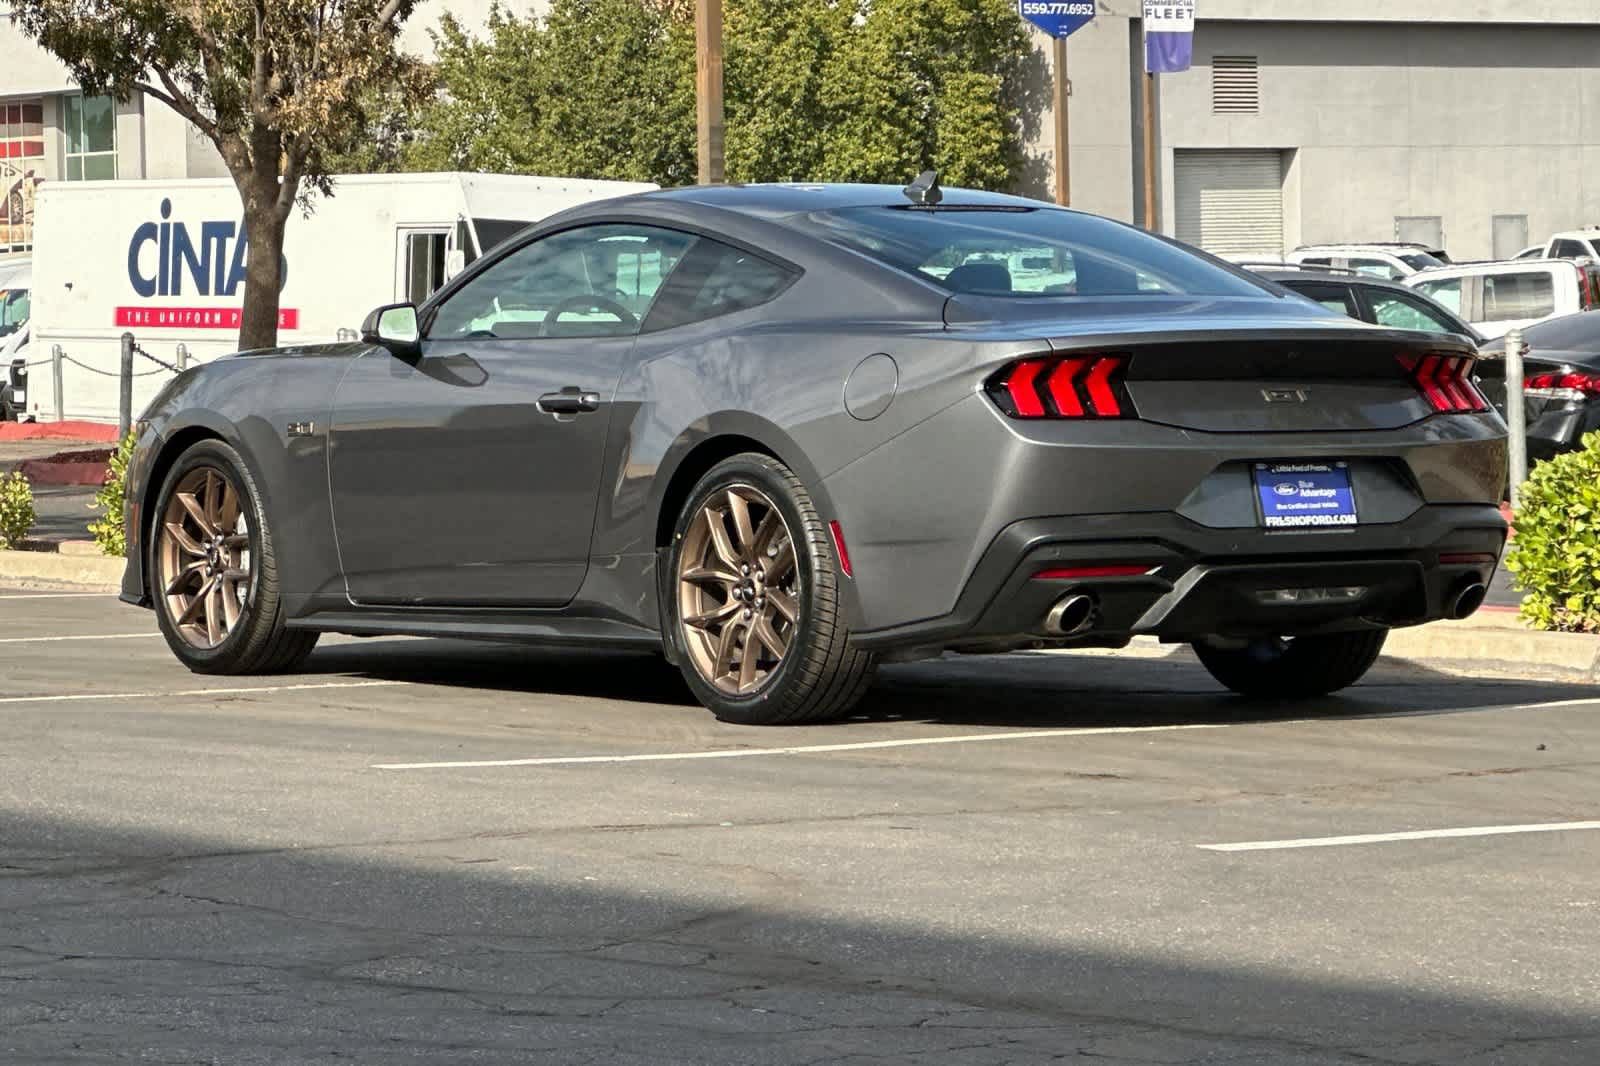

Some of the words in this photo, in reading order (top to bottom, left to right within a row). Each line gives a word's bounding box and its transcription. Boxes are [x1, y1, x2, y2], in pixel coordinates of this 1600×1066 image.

[1023, 3, 1094, 15] 559.777.6952
[1145, 8, 1193, 19] FLEET
[127, 311, 150, 323] THE
[159, 312, 221, 324] UNIFORM
[1300, 488, 1337, 498] Advantage
[1265, 514, 1358, 527] FRESNOFORD.COM
